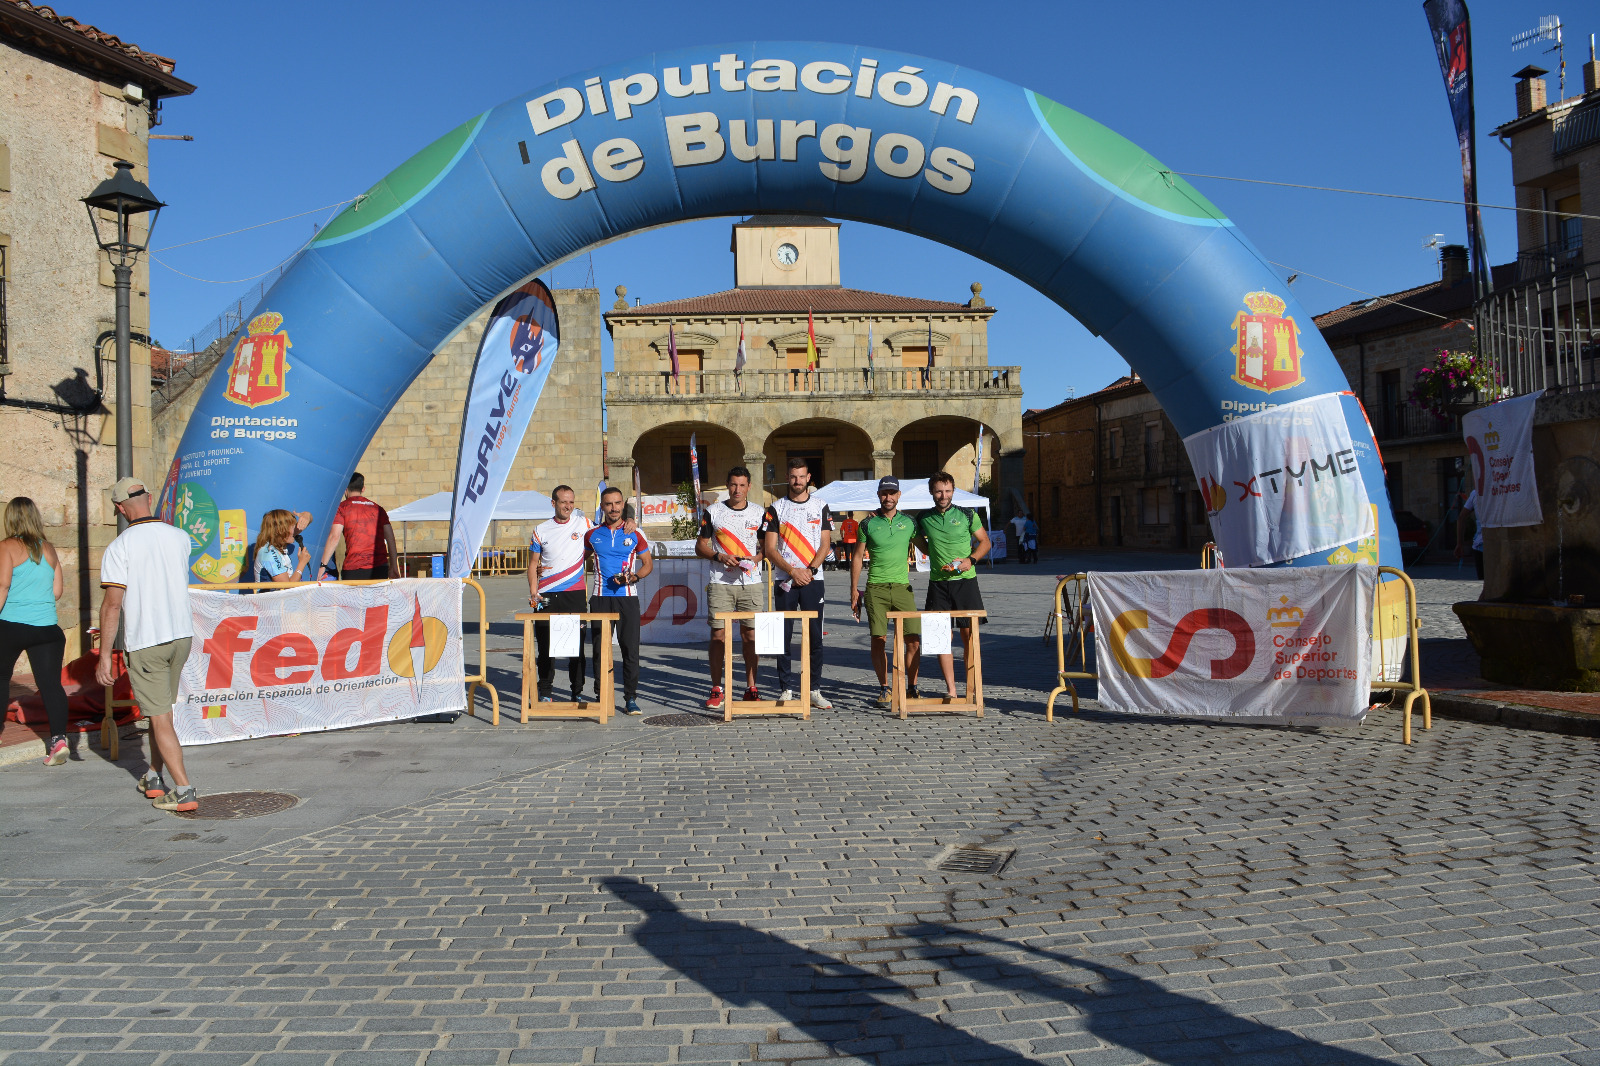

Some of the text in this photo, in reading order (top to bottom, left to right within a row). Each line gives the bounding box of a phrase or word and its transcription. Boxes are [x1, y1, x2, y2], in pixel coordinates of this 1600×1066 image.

[525, 53, 979, 135] Diputación
[541, 111, 976, 200] de Burgos
[506, 383, 521, 419] Burgos
[211, 415, 298, 428] Diputación
[210, 428, 297, 441] de Burgos
[182, 447, 244, 462] INSTITUTO PROVINCIAL
[181, 462, 192, 470] PARA
[203, 457, 230, 467] DEPORTE
[184, 468, 212, 479] JUVENTUD
[1273, 632, 1332, 648] Consejo
[1275, 649, 1338, 665] Superior
[1273, 665, 1358, 682] de Deportes
[187, 674, 399, 704] Federación Española de Orientación
